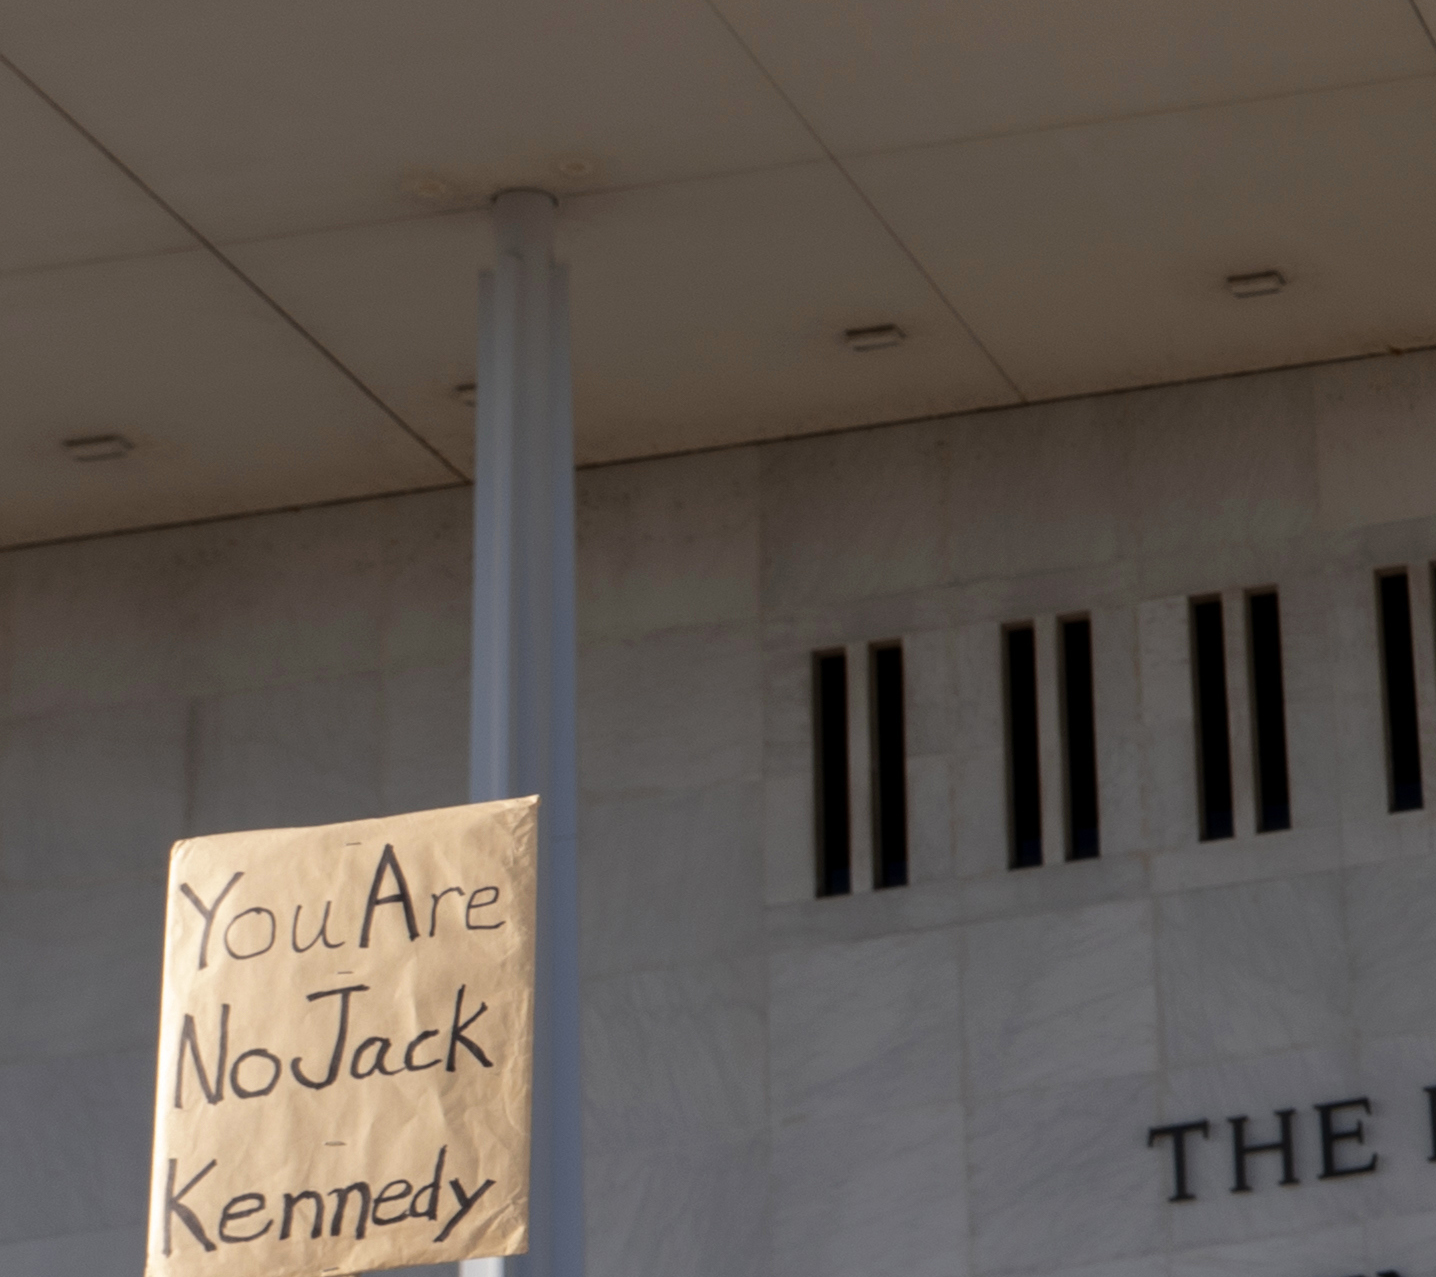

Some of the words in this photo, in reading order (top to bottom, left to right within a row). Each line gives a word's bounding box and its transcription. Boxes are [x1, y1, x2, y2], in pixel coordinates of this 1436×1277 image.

[179, 870, 347, 971] You
[358, 843, 507, 951] Are
[174, 1002, 281, 1110] No
[289, 983, 494, 1091] Jack
[160, 1145, 497, 1258] Kennedy
[1147, 1096, 1379, 1203] THE
